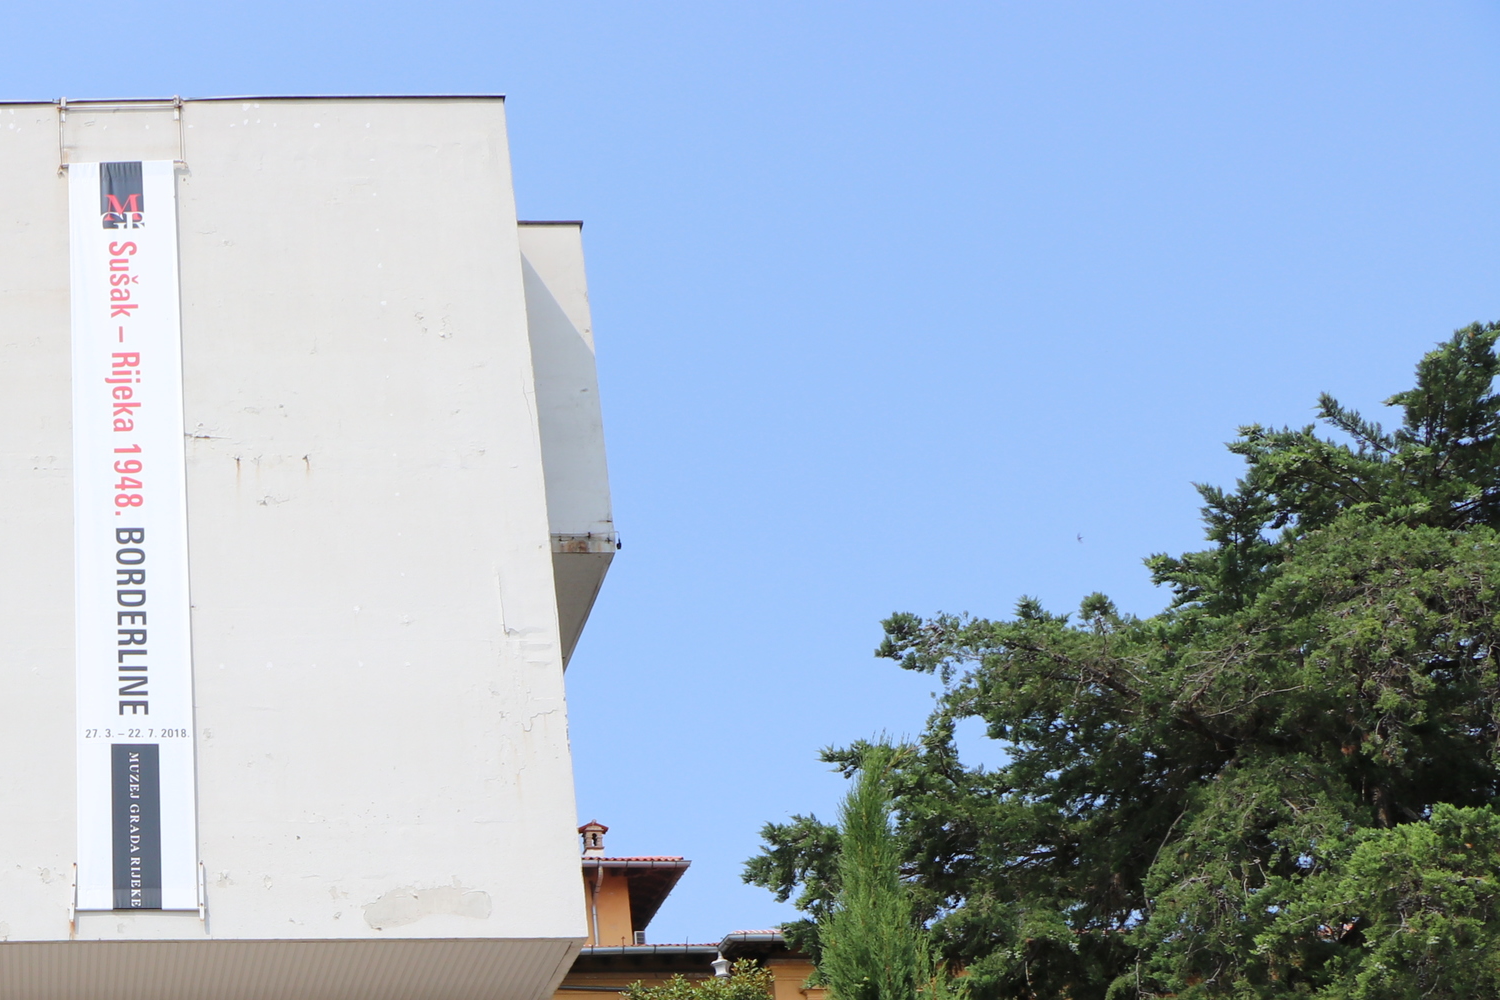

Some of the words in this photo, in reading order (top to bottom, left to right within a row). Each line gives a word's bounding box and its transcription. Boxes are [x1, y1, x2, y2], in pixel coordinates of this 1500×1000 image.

[108, 241, 139, 318] Sušak
[104, 352, 142, 432] Rijeka
[113, 443, 144, 516] 1948.
[115, 527, 149, 715] BORDERLINE
[85, 729, 101, 739] 27.
[105, 729, 115, 738] 3.
[128, 729, 144, 738] 22.
[148, 729, 158, 738] 7.
[161, 728, 190, 738] 2018.
[128, 752, 140, 799] MUZEJ
[129, 803, 142, 853] GRADA
[130, 857, 142, 907] RIJEKE
